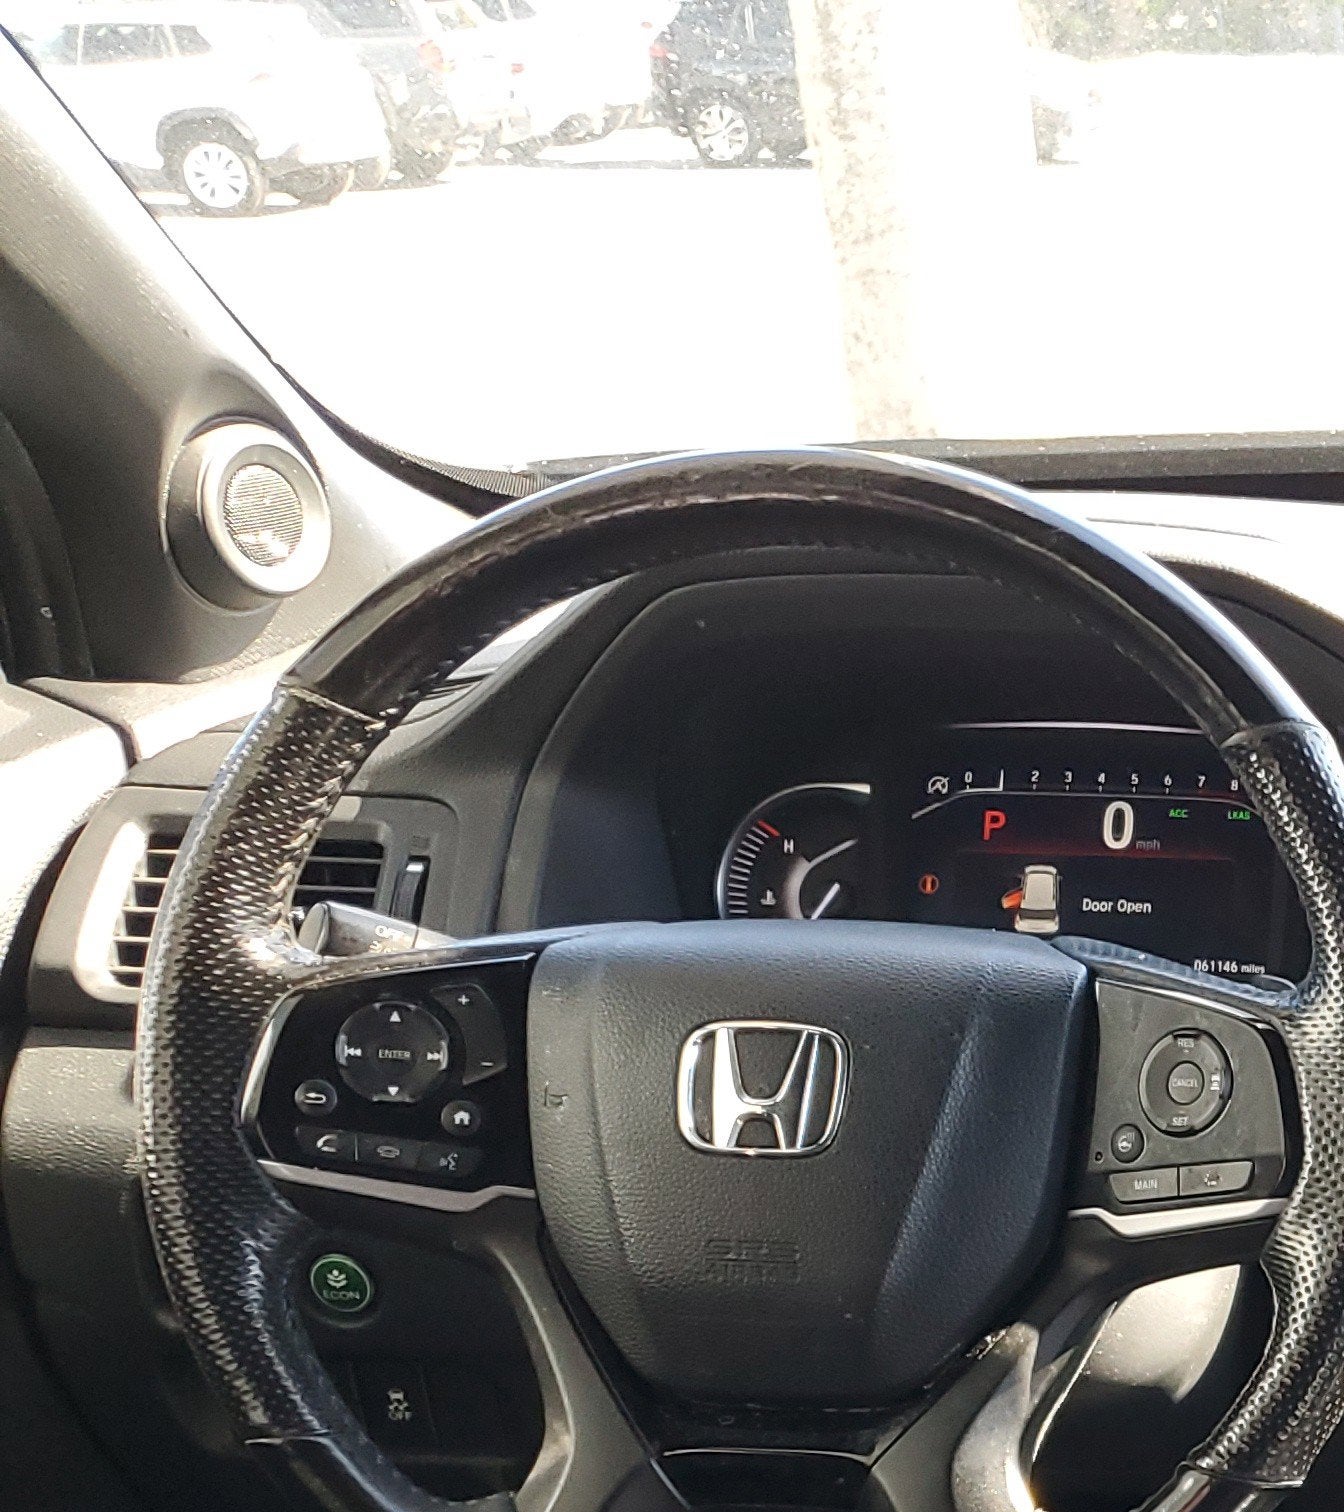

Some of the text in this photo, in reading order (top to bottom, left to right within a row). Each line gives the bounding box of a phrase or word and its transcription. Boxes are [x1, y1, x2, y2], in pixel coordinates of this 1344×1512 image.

[1031, 770, 1040, 782] 2
[1064, 771, 1073, 783] 3
[1097, 772, 1106, 784] 4
[1131, 773, 1139, 785] 5
[1164, 774, 1173, 786] 6
[1198, 775, 1206, 788] 7
[1230, 779, 1239, 791] 8
[982, 809, 1007, 841] P
[1103, 801, 1161, 851] 0 mph
[783, 838, 795, 854] H
[1082, 897, 1152, 914] Door Open
[1193, 959, 1266, 974] 061146 miles
[1171, 1077, 1199, 1088] CANCEL
[1171, 1116, 1190, 1127] SET
[1134, 1179, 1158, 1190] MAIN
